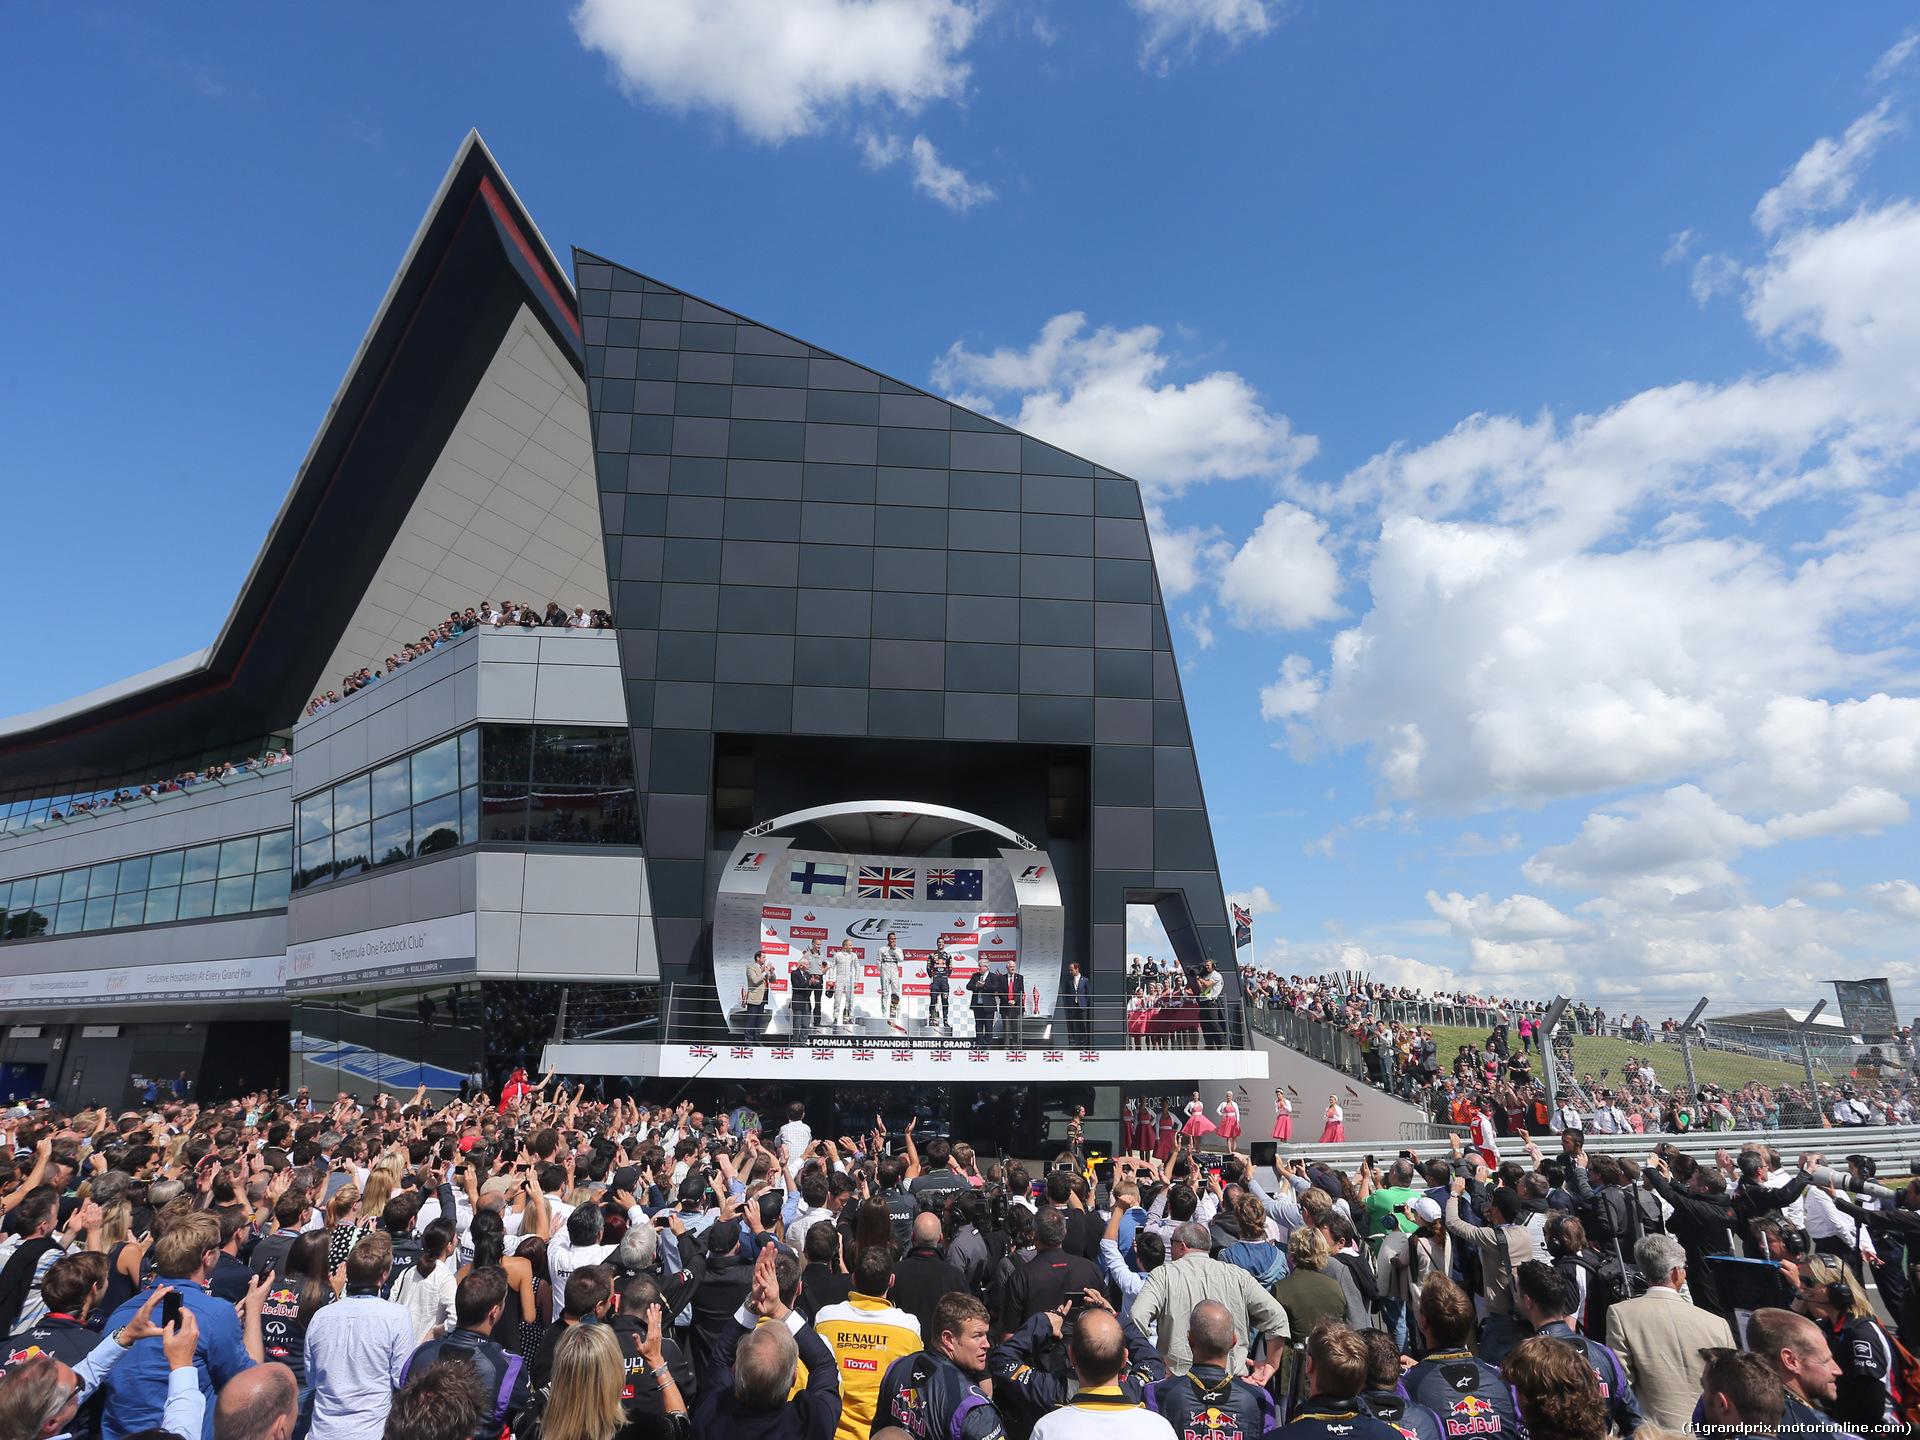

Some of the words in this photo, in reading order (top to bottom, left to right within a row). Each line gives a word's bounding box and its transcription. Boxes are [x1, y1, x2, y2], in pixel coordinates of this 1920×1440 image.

[763, 907, 790, 917] Santander
[800, 930, 826, 938] Santander
[331, 950, 341, 962] The
[342, 944, 365, 959] Formula
[366, 943, 379, 956] One
[380, 937, 407, 954] Paddock
[408, 935, 424, 950] Club
[762, 944, 788, 952] Santander
[222, 969, 239, 980] Grand
[813, 1039, 852, 1047] FORMULA
[260, 1303, 280, 1316] Red
[280, 1304, 299, 1318] Bull
[838, 1332, 888, 1345] RENAULT
[846, 1360, 876, 1370] TOTAL
[892, 1398, 908, 1426] Red
[908, 1408, 926, 1438] Bull
[1447, 1417, 1475, 1435] Red
[1476, 1415, 1501, 1434] Bull
